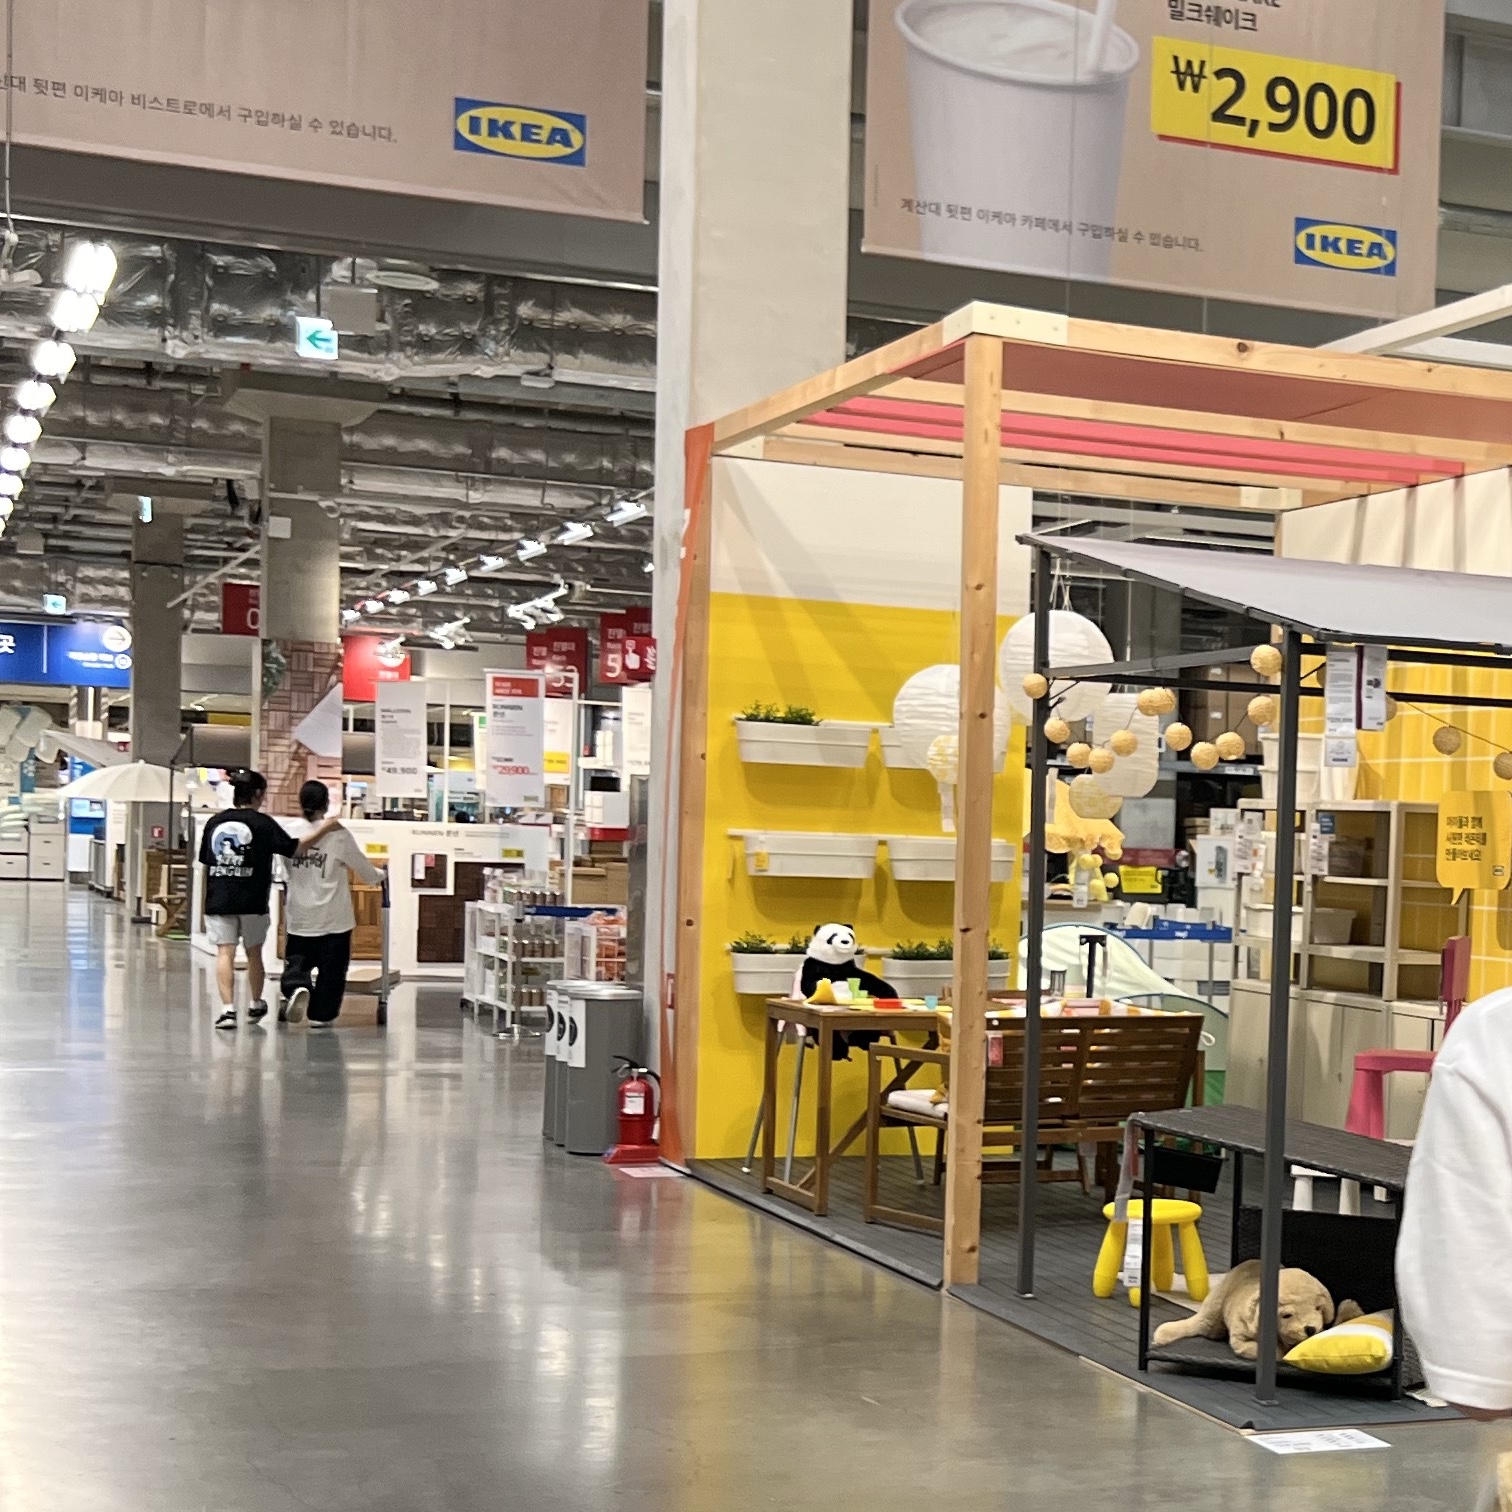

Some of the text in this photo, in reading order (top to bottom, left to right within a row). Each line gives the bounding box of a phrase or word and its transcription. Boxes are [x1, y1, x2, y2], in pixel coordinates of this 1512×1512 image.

[33, 78, 66, 98] 뒷편
[73, 85, 124, 107] 이케아
[131, 92, 231, 121] 비스트로에서
[237, 106, 302, 131] 구입하실
[308, 118, 323, 133] 수
[329, 120, 397, 143] 있습니다.
[1170, 54, 1376, 146] ₩2,900
[468, 115, 574, 149] IKEA
[901, 198, 942, 216] 계산대
[946, 203, 972, 221] 뒷편
[976, 209, 1016, 227] 이케아
[1020, 214, 1072, 235] 카페에서
[1077, 222, 1129, 243] 구입하실
[1133, 230, 1145, 244] 수
[1305, 232, 1388, 261] IKEA
